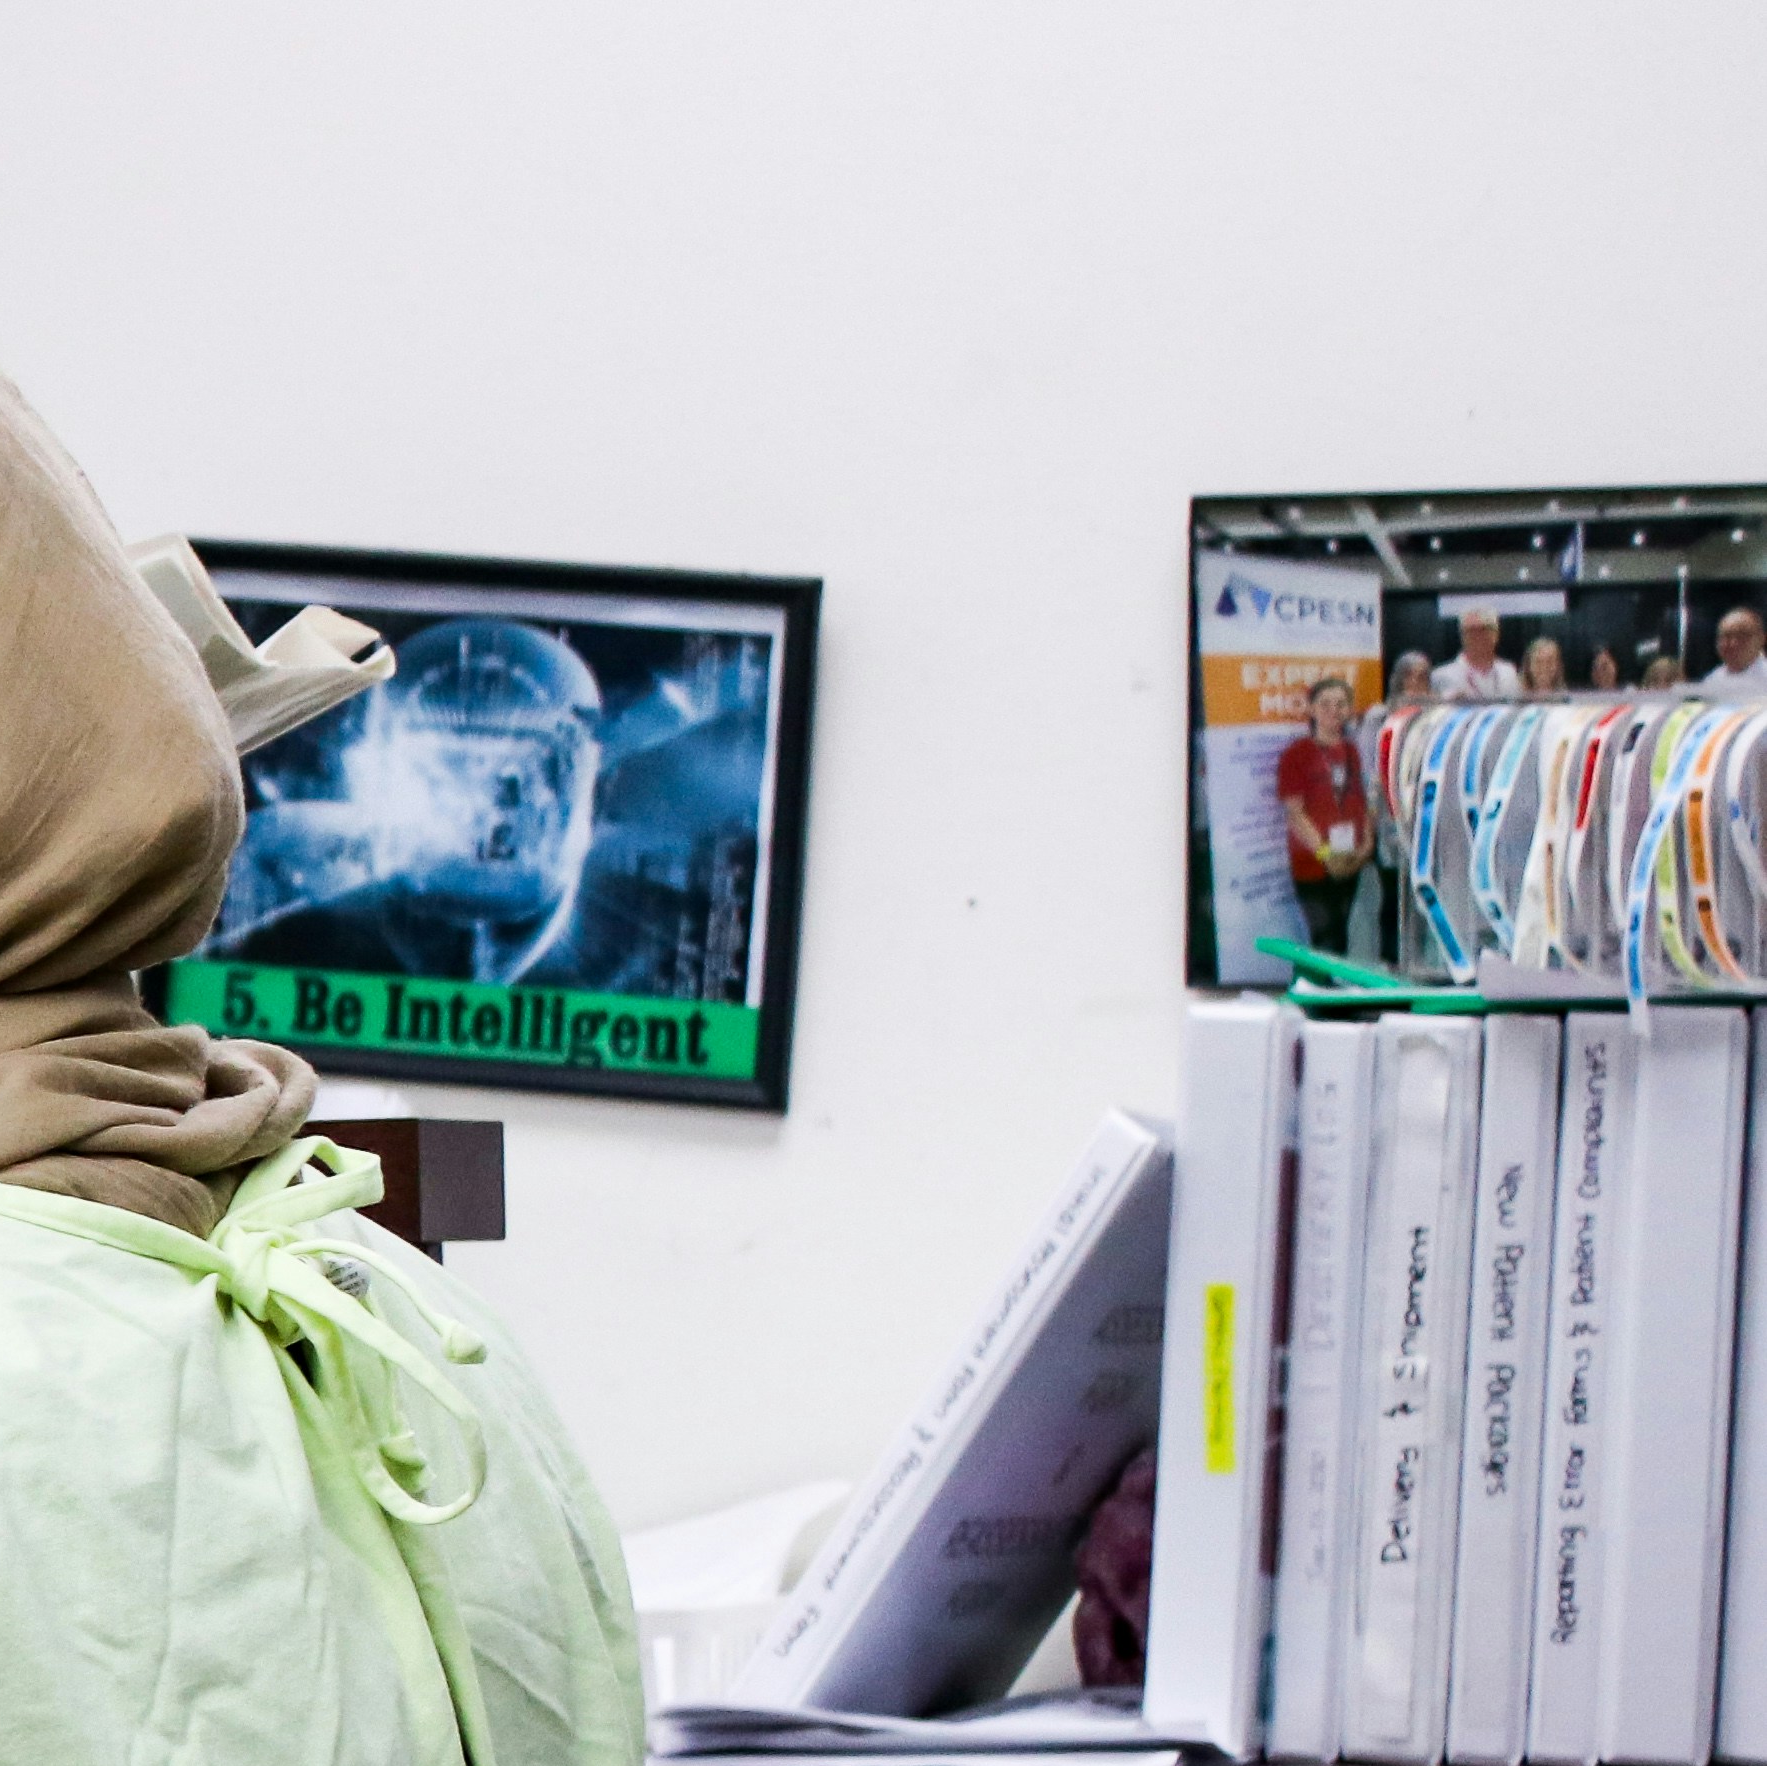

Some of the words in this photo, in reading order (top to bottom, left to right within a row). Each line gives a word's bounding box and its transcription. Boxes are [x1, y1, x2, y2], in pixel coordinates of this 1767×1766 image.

[1274, 593, 1375, 626] CPESN
[221, 970, 271, 1030] 5.
[292, 976, 364, 1039] Be
[383, 984, 710, 1071] Intelligent
[1379, 1447, 1419, 1566] Delivery
[1550, 1525, 1588, 1646] Reporting
